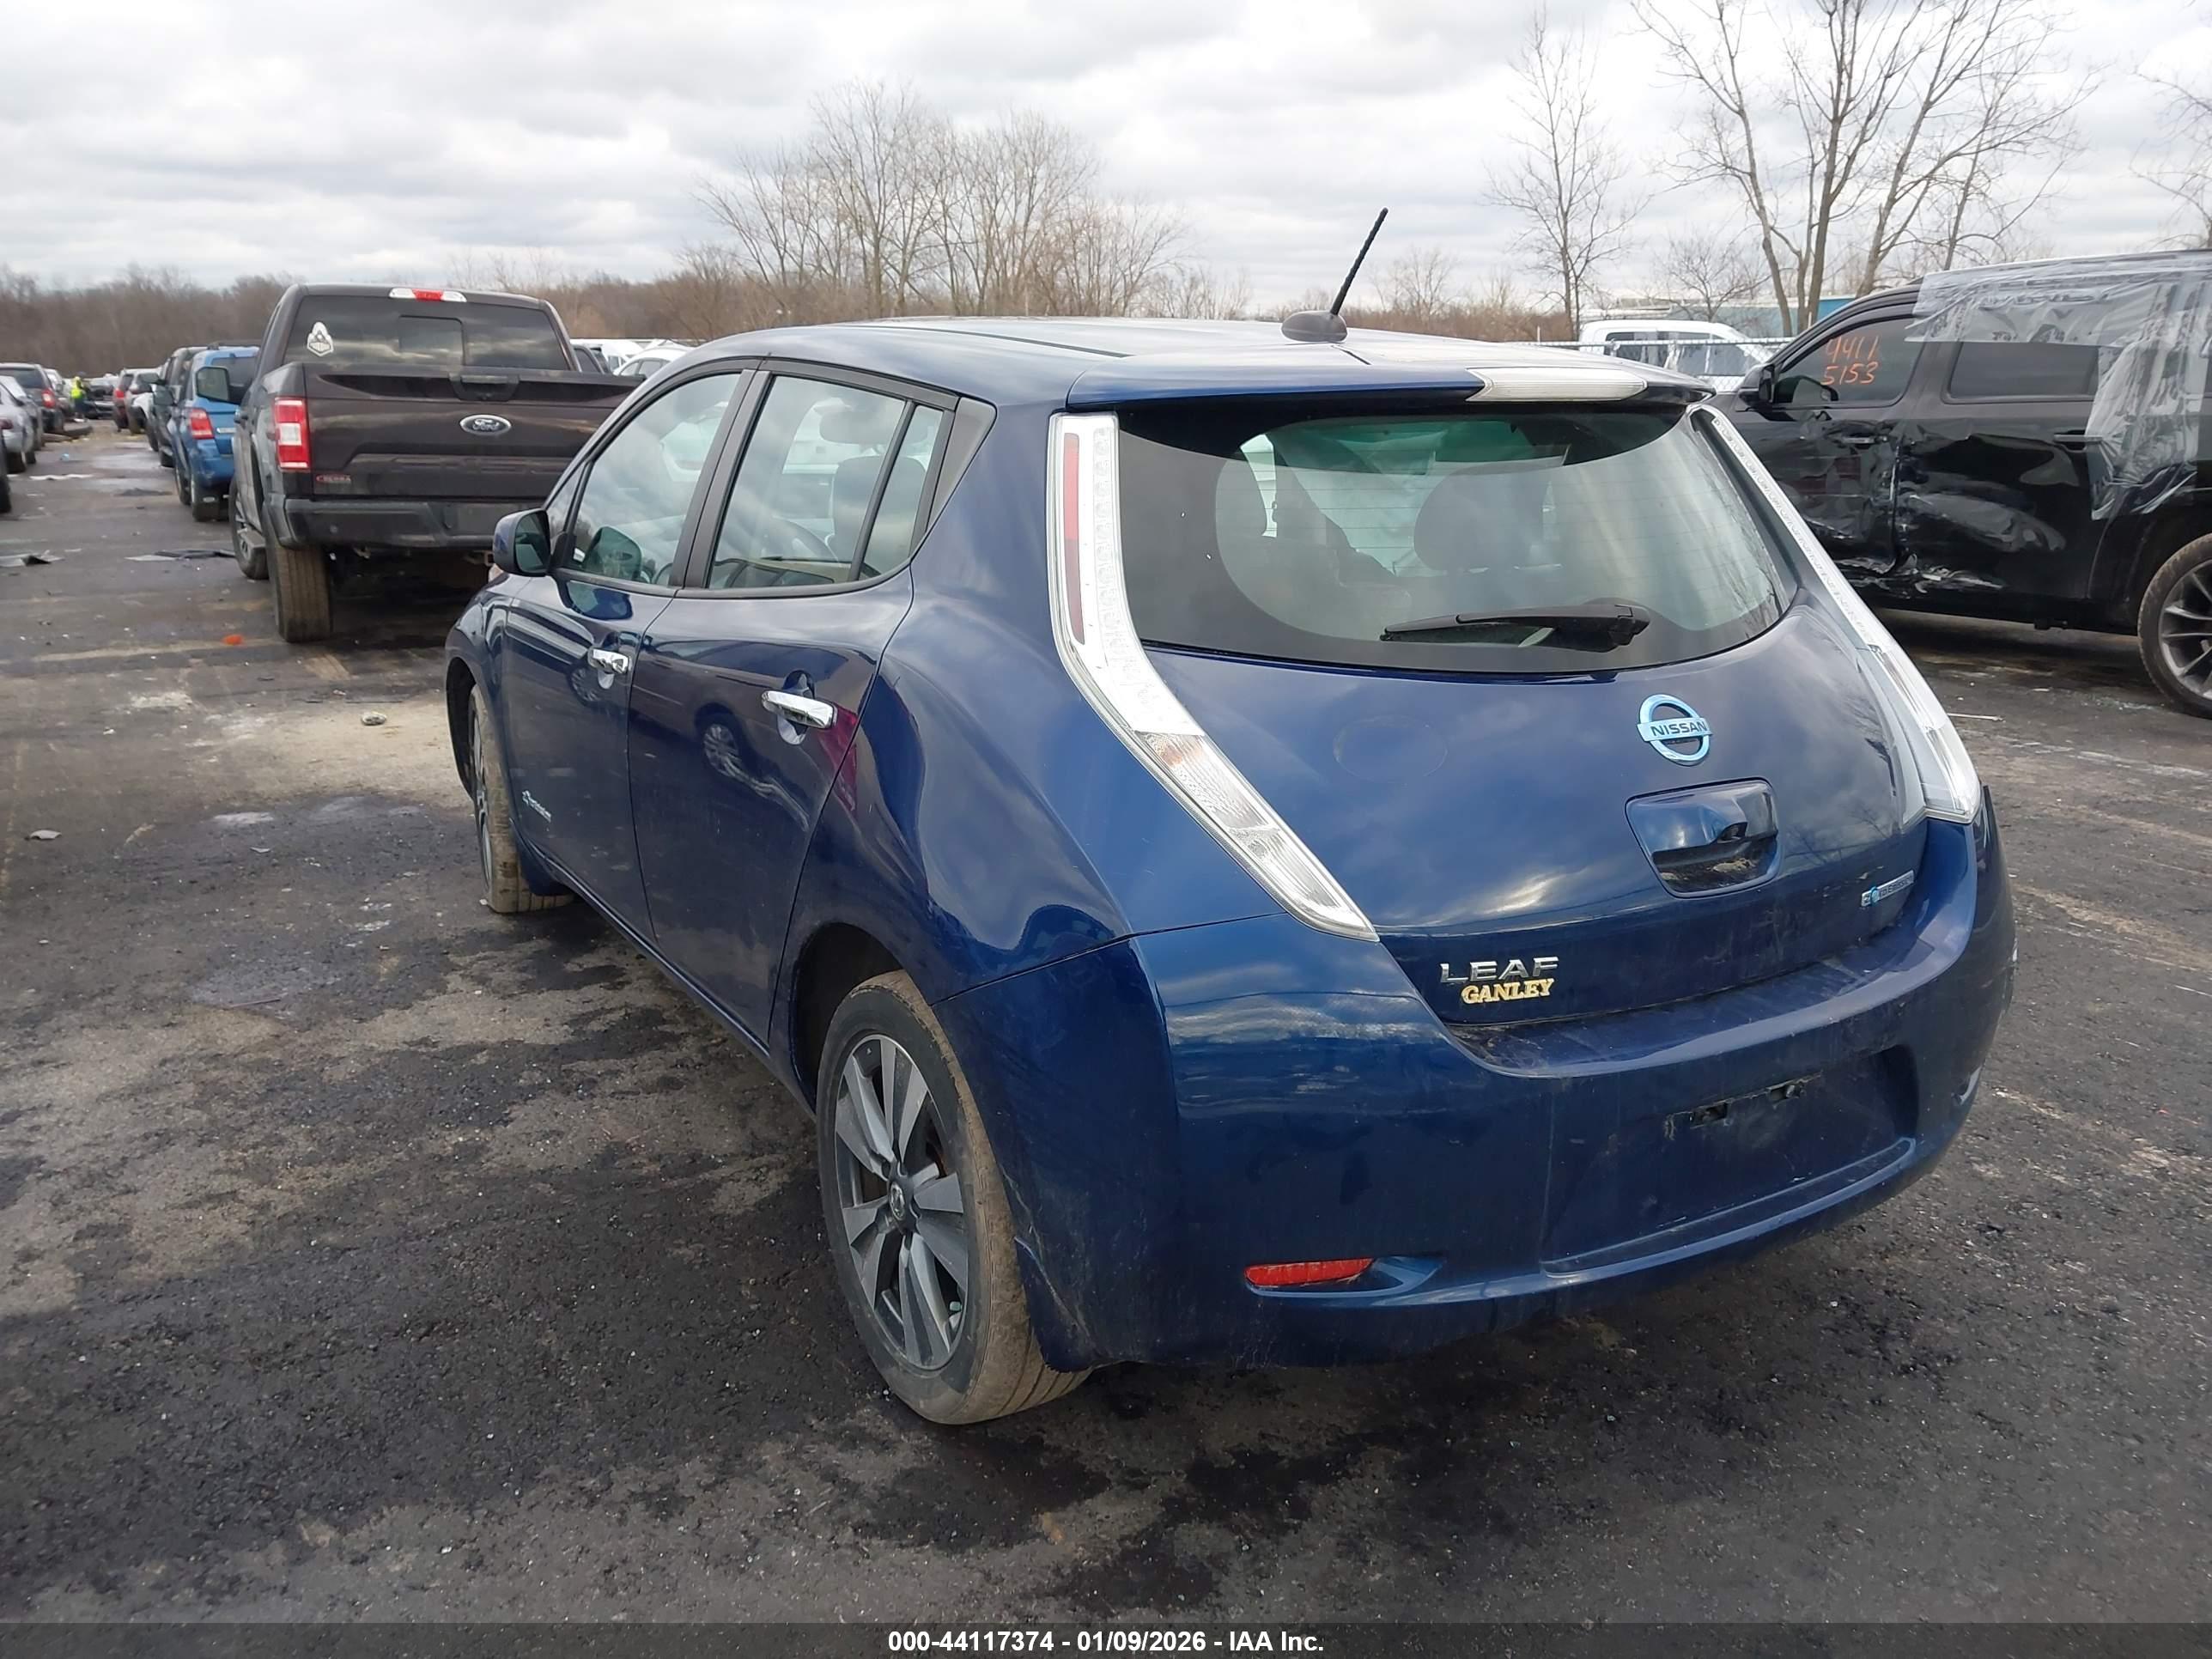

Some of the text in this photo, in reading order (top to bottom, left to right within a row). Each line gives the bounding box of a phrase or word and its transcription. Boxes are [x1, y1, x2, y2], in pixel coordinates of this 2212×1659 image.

[1820, 361, 1879, 386] 5153
[1650, 721, 1708, 737] NISSAN
[1439, 956, 1559, 983] LEAF
[1461, 978, 1555, 1005] GANLEY
